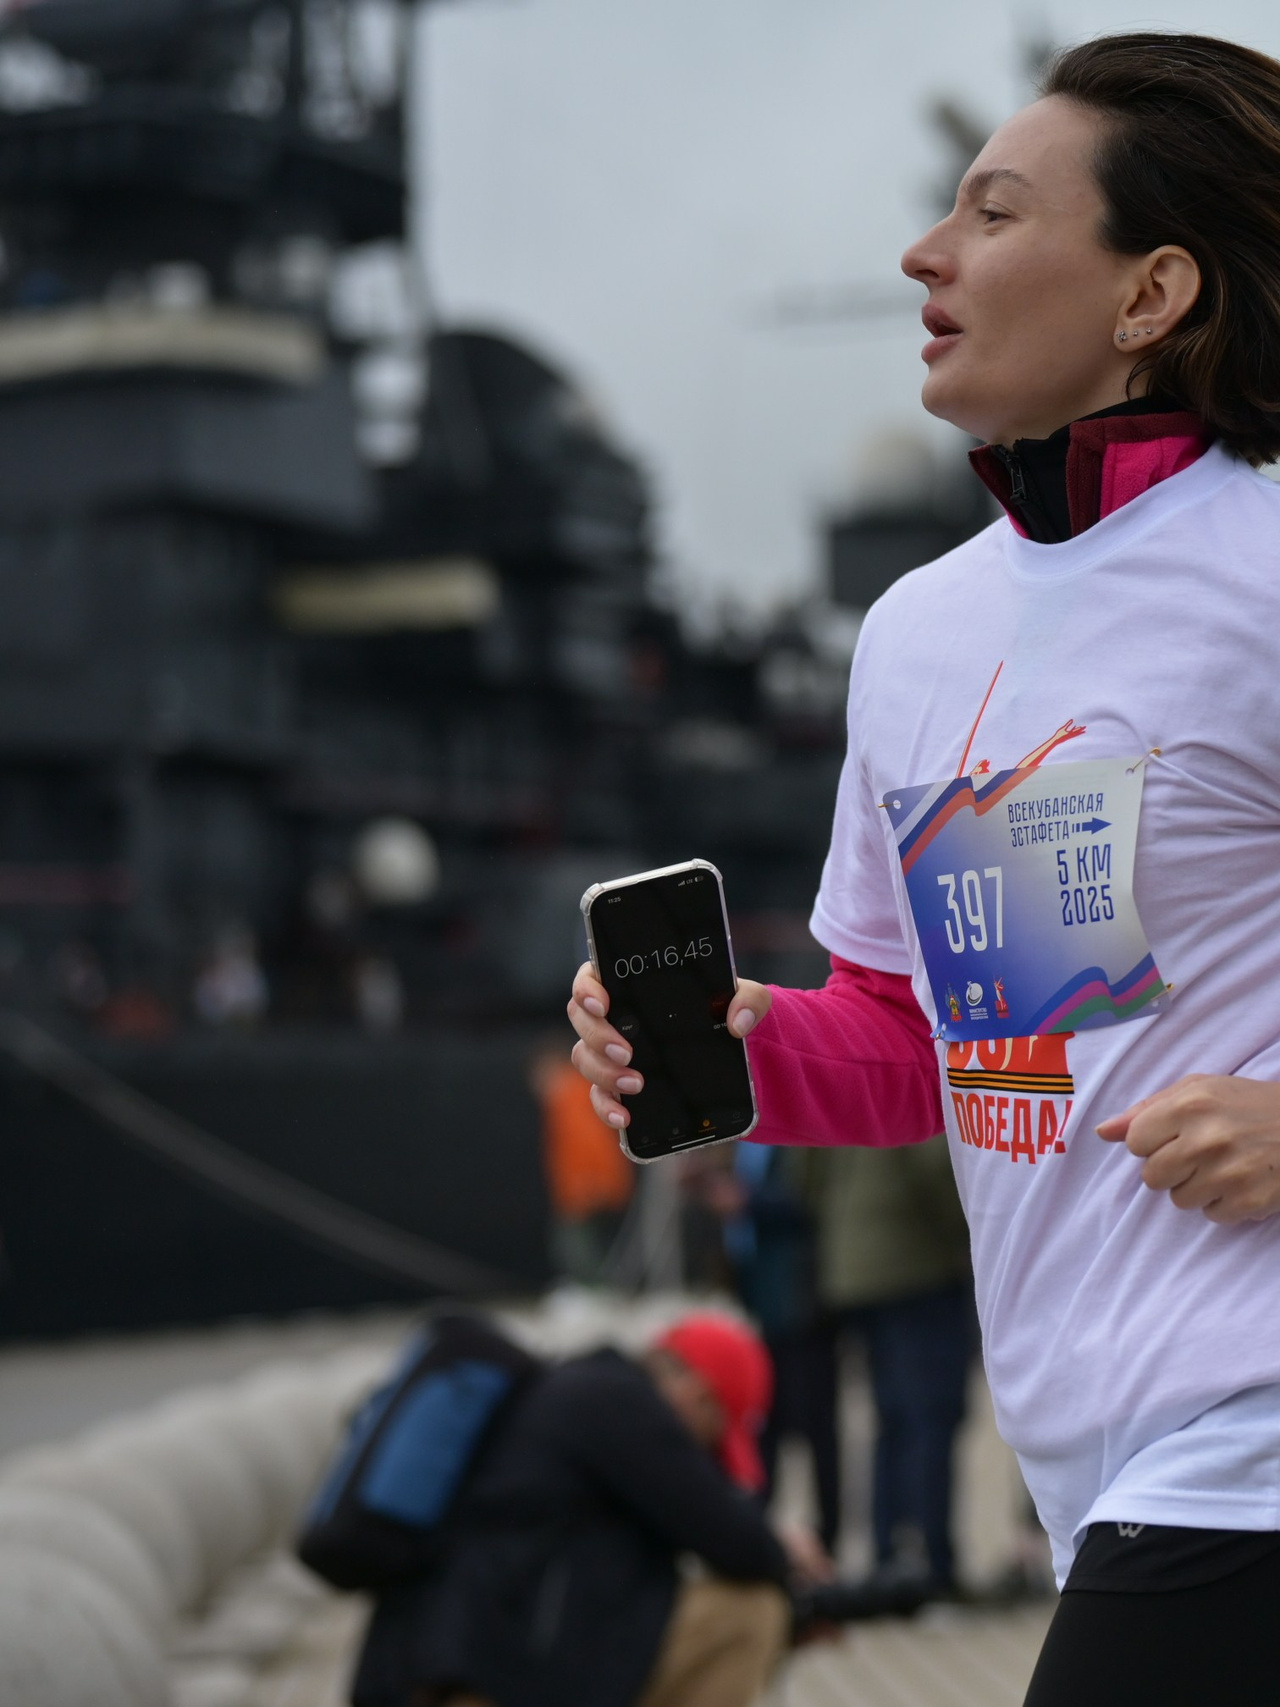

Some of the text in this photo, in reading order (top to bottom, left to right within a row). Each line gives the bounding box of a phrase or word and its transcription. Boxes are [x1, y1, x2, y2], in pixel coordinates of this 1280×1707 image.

[1007, 793, 1104, 823] ВСЕКУБАНСКАЯ
[1010, 820, 1069, 847] ЭСТАФЕТА
[1056, 843, 1111, 885] 5 КМ
[937, 866, 1004, 954] 397
[1060, 884, 1114, 926] 2025
[614, 937, 713, 979] 00:16,45
[950, 1091, 1073, 1164] ПОБЕДА!
